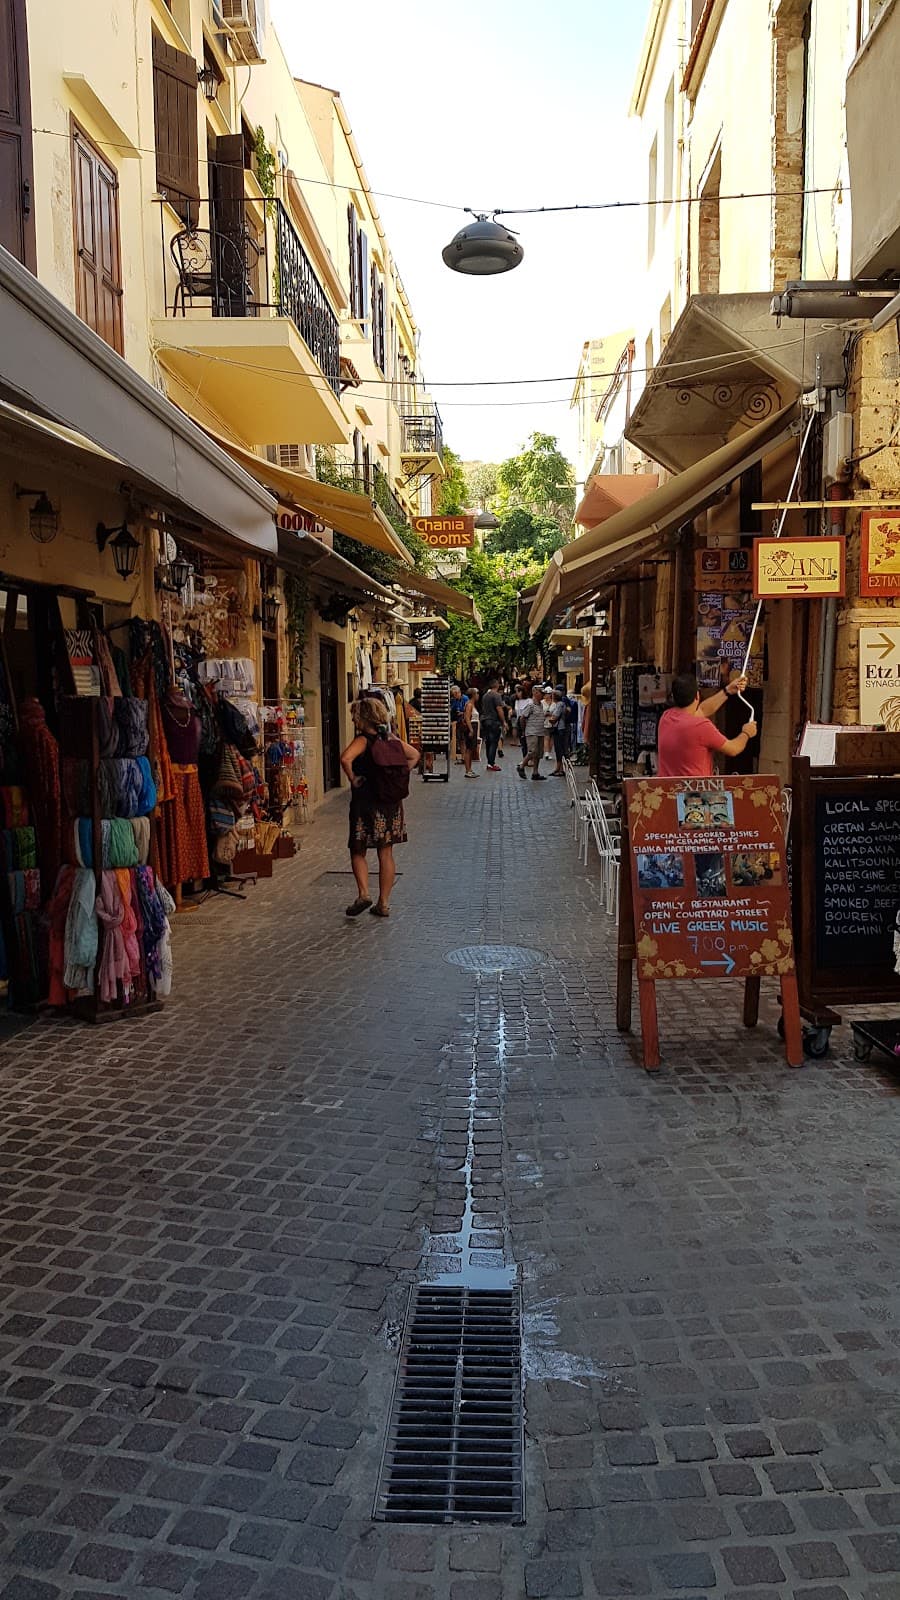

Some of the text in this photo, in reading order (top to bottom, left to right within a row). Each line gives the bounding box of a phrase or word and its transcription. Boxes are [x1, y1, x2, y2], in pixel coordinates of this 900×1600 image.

[275, 514, 325, 532] OOMS
[416, 519, 464, 531] Chania
[720, 640, 746, 649] take
[864, 664, 893, 679] Etz
[825, 800, 870, 814] LOCAL
[823, 822, 865, 833] CRETAN
[644, 830, 759, 841] SPECIALLY COOKED DISHES
[717, 836, 739, 844] POTS
[823, 836, 873, 846] AVOCADO
[823, 845, 896, 856] DOLMADAKIA
[824, 870, 886, 881] AUBERGINE
[824, 883, 856, 894] APAKI
[651, 898, 751, 910] FAMILY RESTAURANT
[823, 897, 869, 909] SMOKED
[644, 911, 671, 920] OPEN
[825, 911, 883, 923] BOUREKI
[652, 919, 769, 934] LIVE GREEK MUSIC
[825, 925, 882, 936] ZUCCHINI
